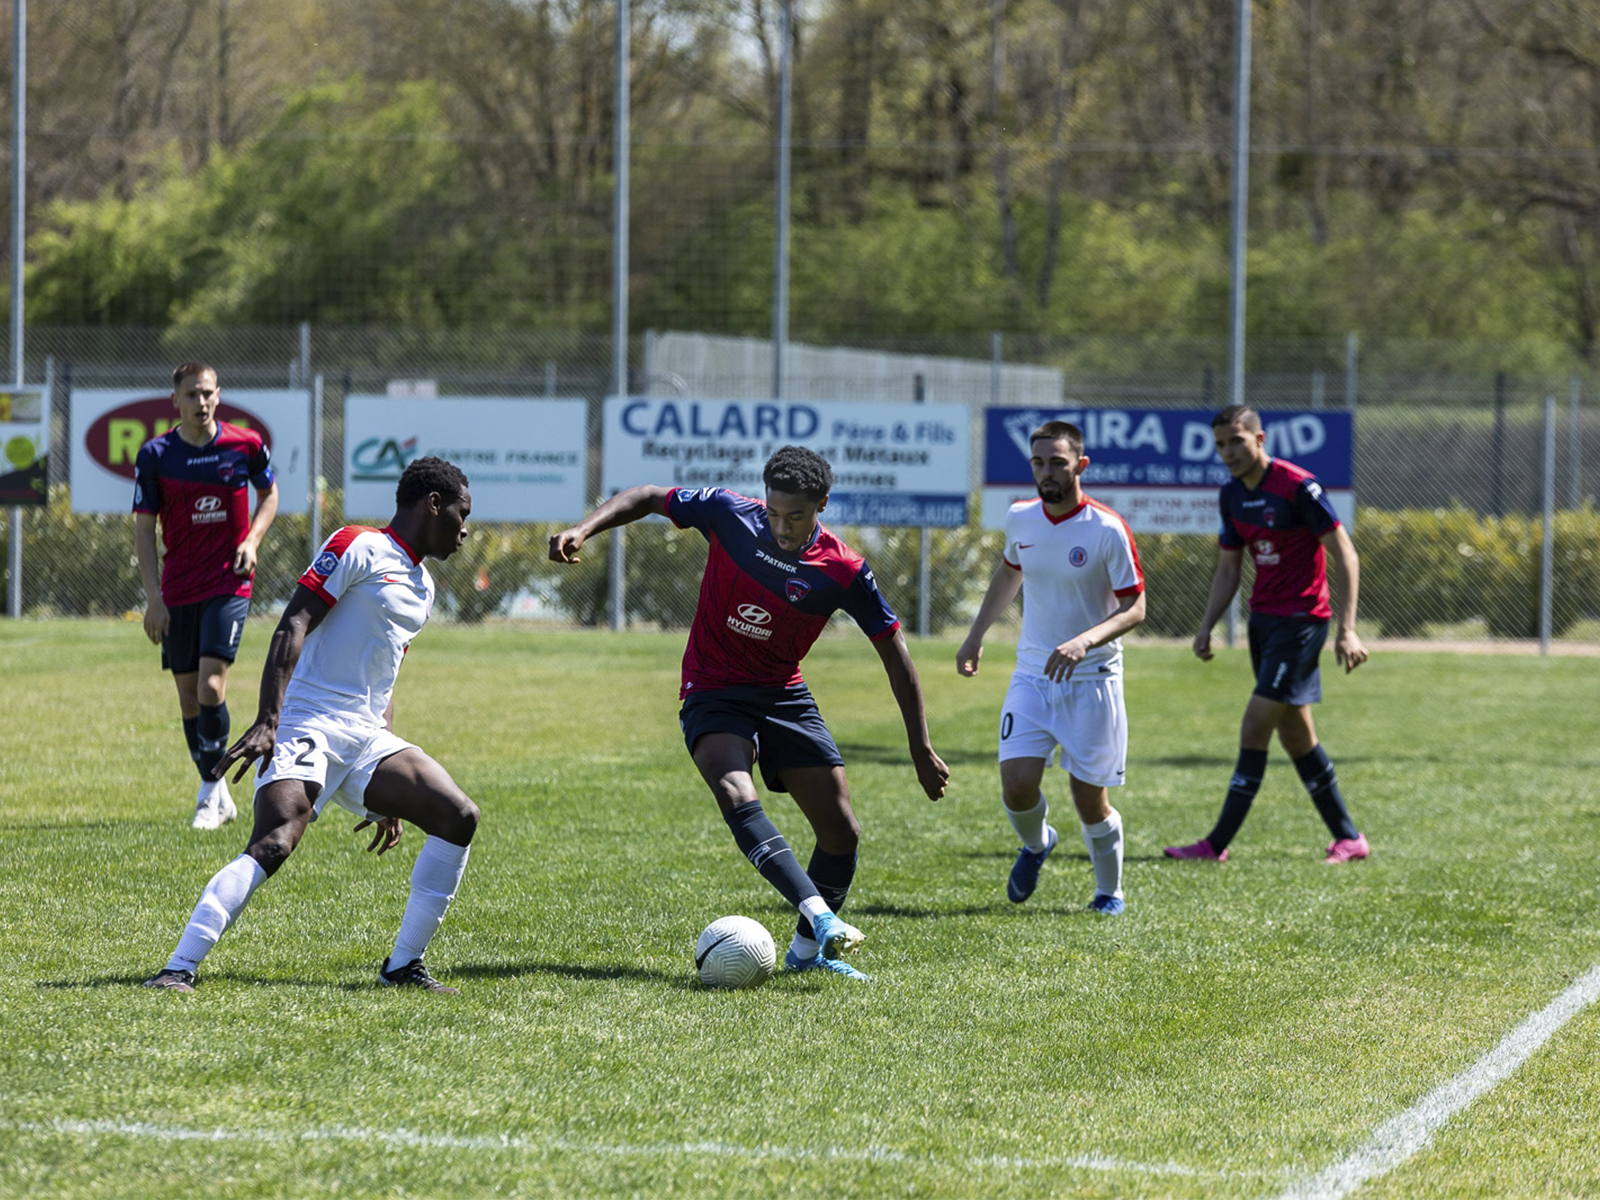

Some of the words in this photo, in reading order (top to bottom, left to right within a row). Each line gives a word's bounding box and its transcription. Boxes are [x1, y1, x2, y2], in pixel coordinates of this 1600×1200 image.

[620, 401, 819, 440] CALARD
[892, 420, 909, 442] &
[914, 421, 956, 446] Fils
[1180, 413, 1327, 464] DVID
[504, 449, 578, 468] FRANCE
[642, 440, 755, 466] Recyclage
[844, 446, 929, 467] Métaux
[763, 554, 797, 574] PATRICK
[727, 615, 773, 637] HYUNDAI
[295, 737, 316, 768] 2
